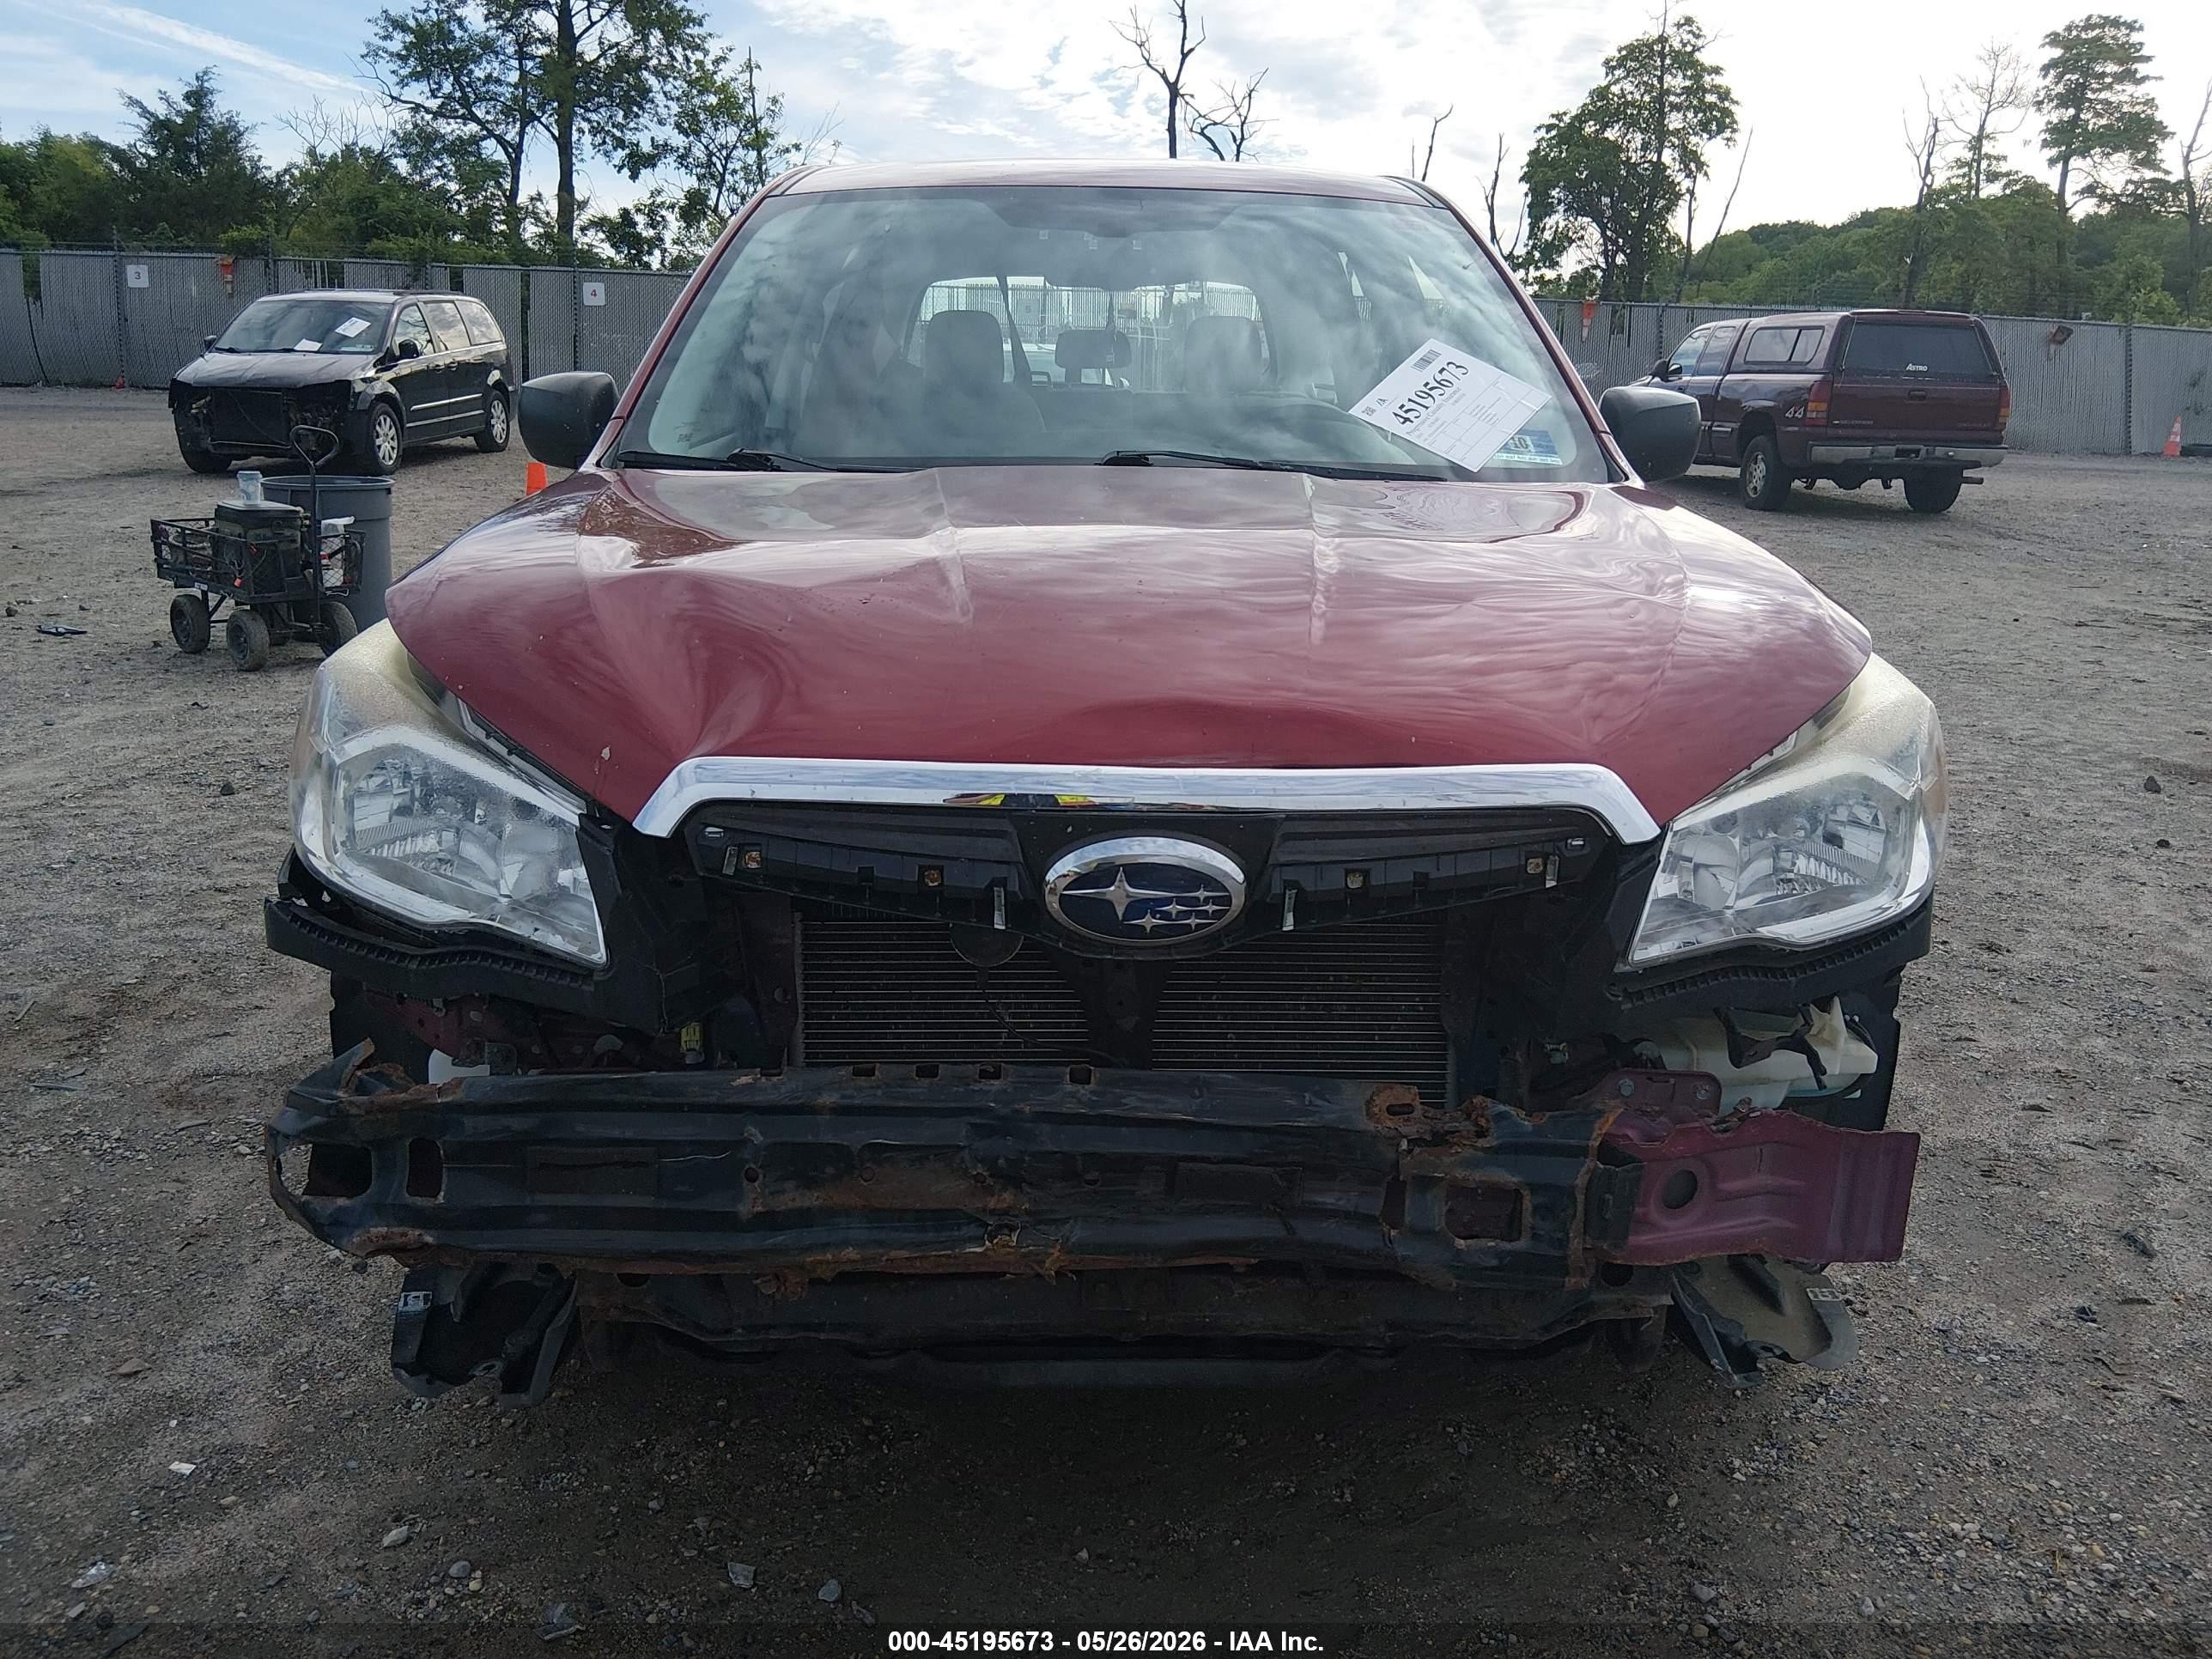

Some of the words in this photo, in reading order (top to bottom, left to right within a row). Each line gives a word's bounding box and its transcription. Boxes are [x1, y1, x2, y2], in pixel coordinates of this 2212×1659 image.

[134, 270, 142, 280] 3
[590, 289, 598, 298] 4
[1391, 361, 1469, 425] 45195673
